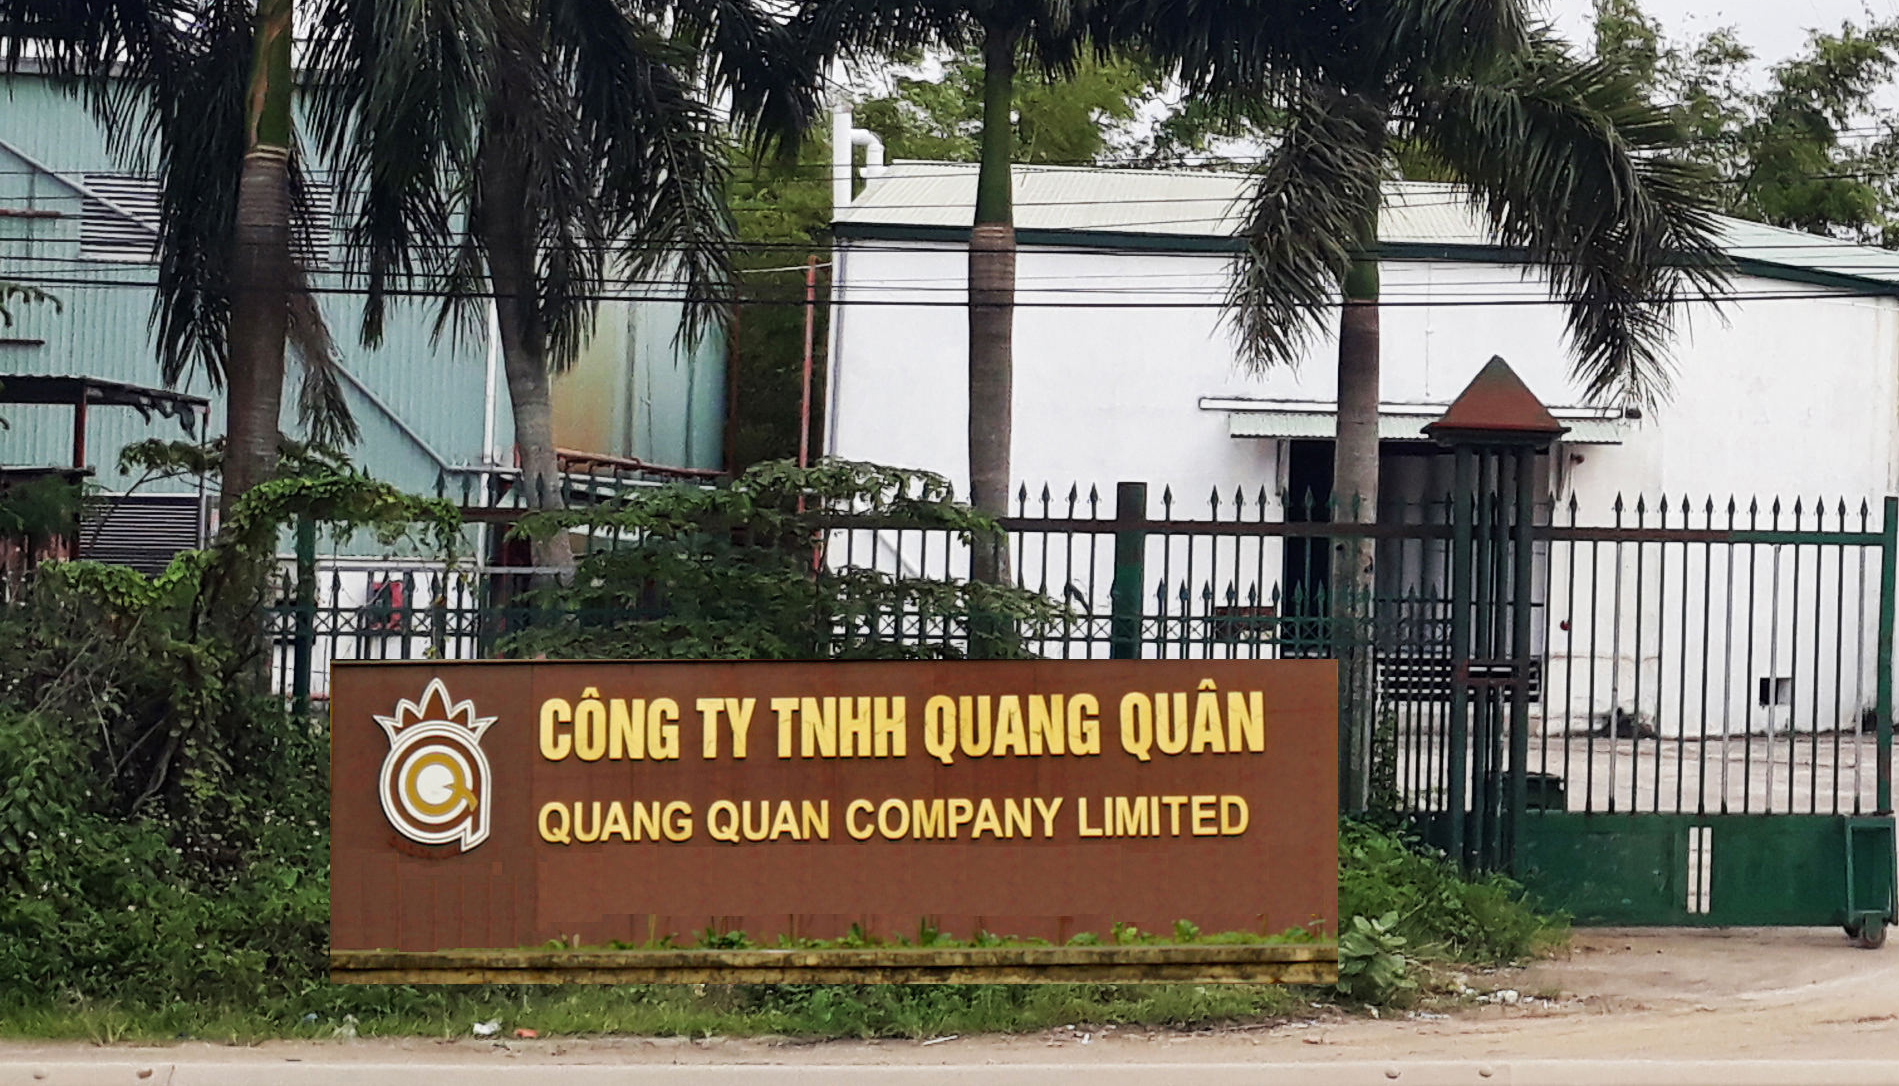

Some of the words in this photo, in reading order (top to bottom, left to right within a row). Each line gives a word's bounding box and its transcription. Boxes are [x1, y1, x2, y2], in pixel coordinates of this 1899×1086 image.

[539, 686, 679, 762] CÔNG
[695, 697, 757, 759] TY
[770, 695, 907, 758] TNHH
[924, 692, 1101, 765] QUANG
[1119, 678, 1265, 762] QUÂN
[538, 800, 693, 844] QUANG
[706, 799, 830, 842] QUAN
[845, 796, 1063, 839] COMPANY
[1077, 794, 1249, 836] LIMITED
